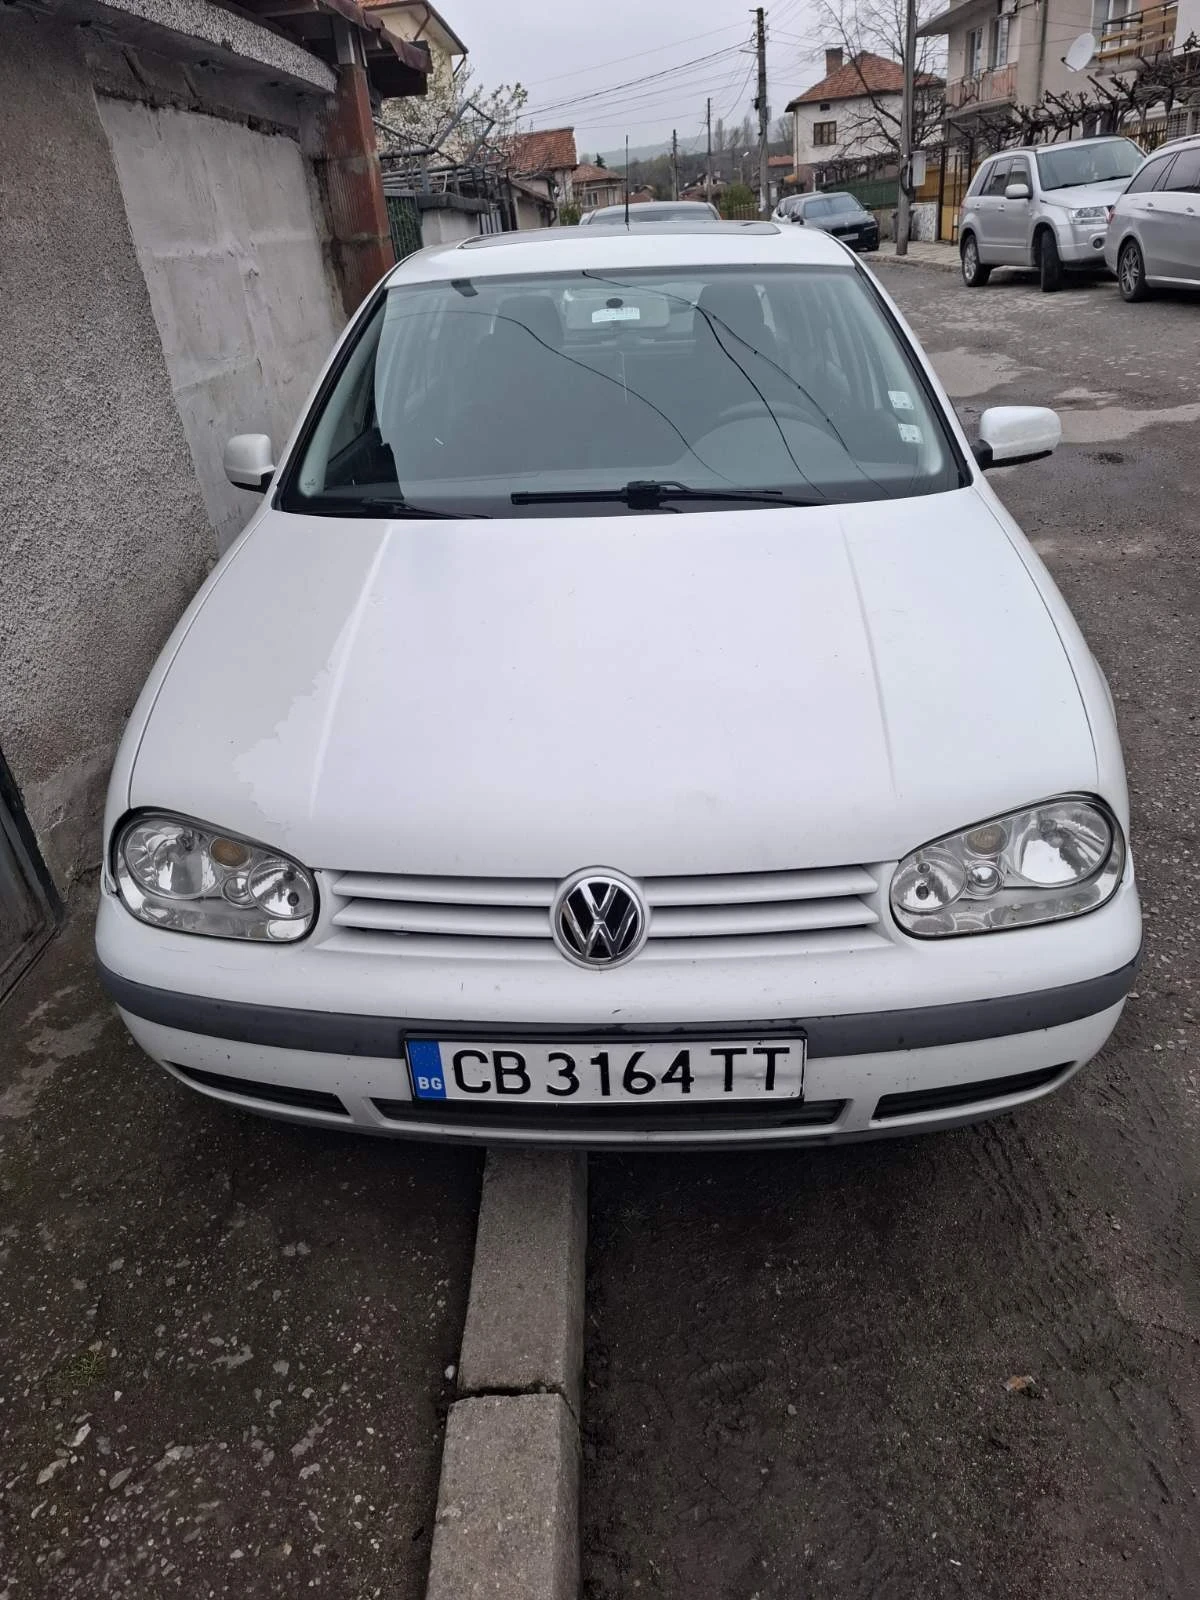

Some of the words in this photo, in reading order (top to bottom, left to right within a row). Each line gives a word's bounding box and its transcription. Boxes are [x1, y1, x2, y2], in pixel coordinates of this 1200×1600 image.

[558, 877, 643, 963] VW
[417, 1076, 443, 1090] BG
[452, 1049, 532, 1095] CB
[546, 1050, 695, 1097] 3164
[710, 1047, 791, 1092] TT
